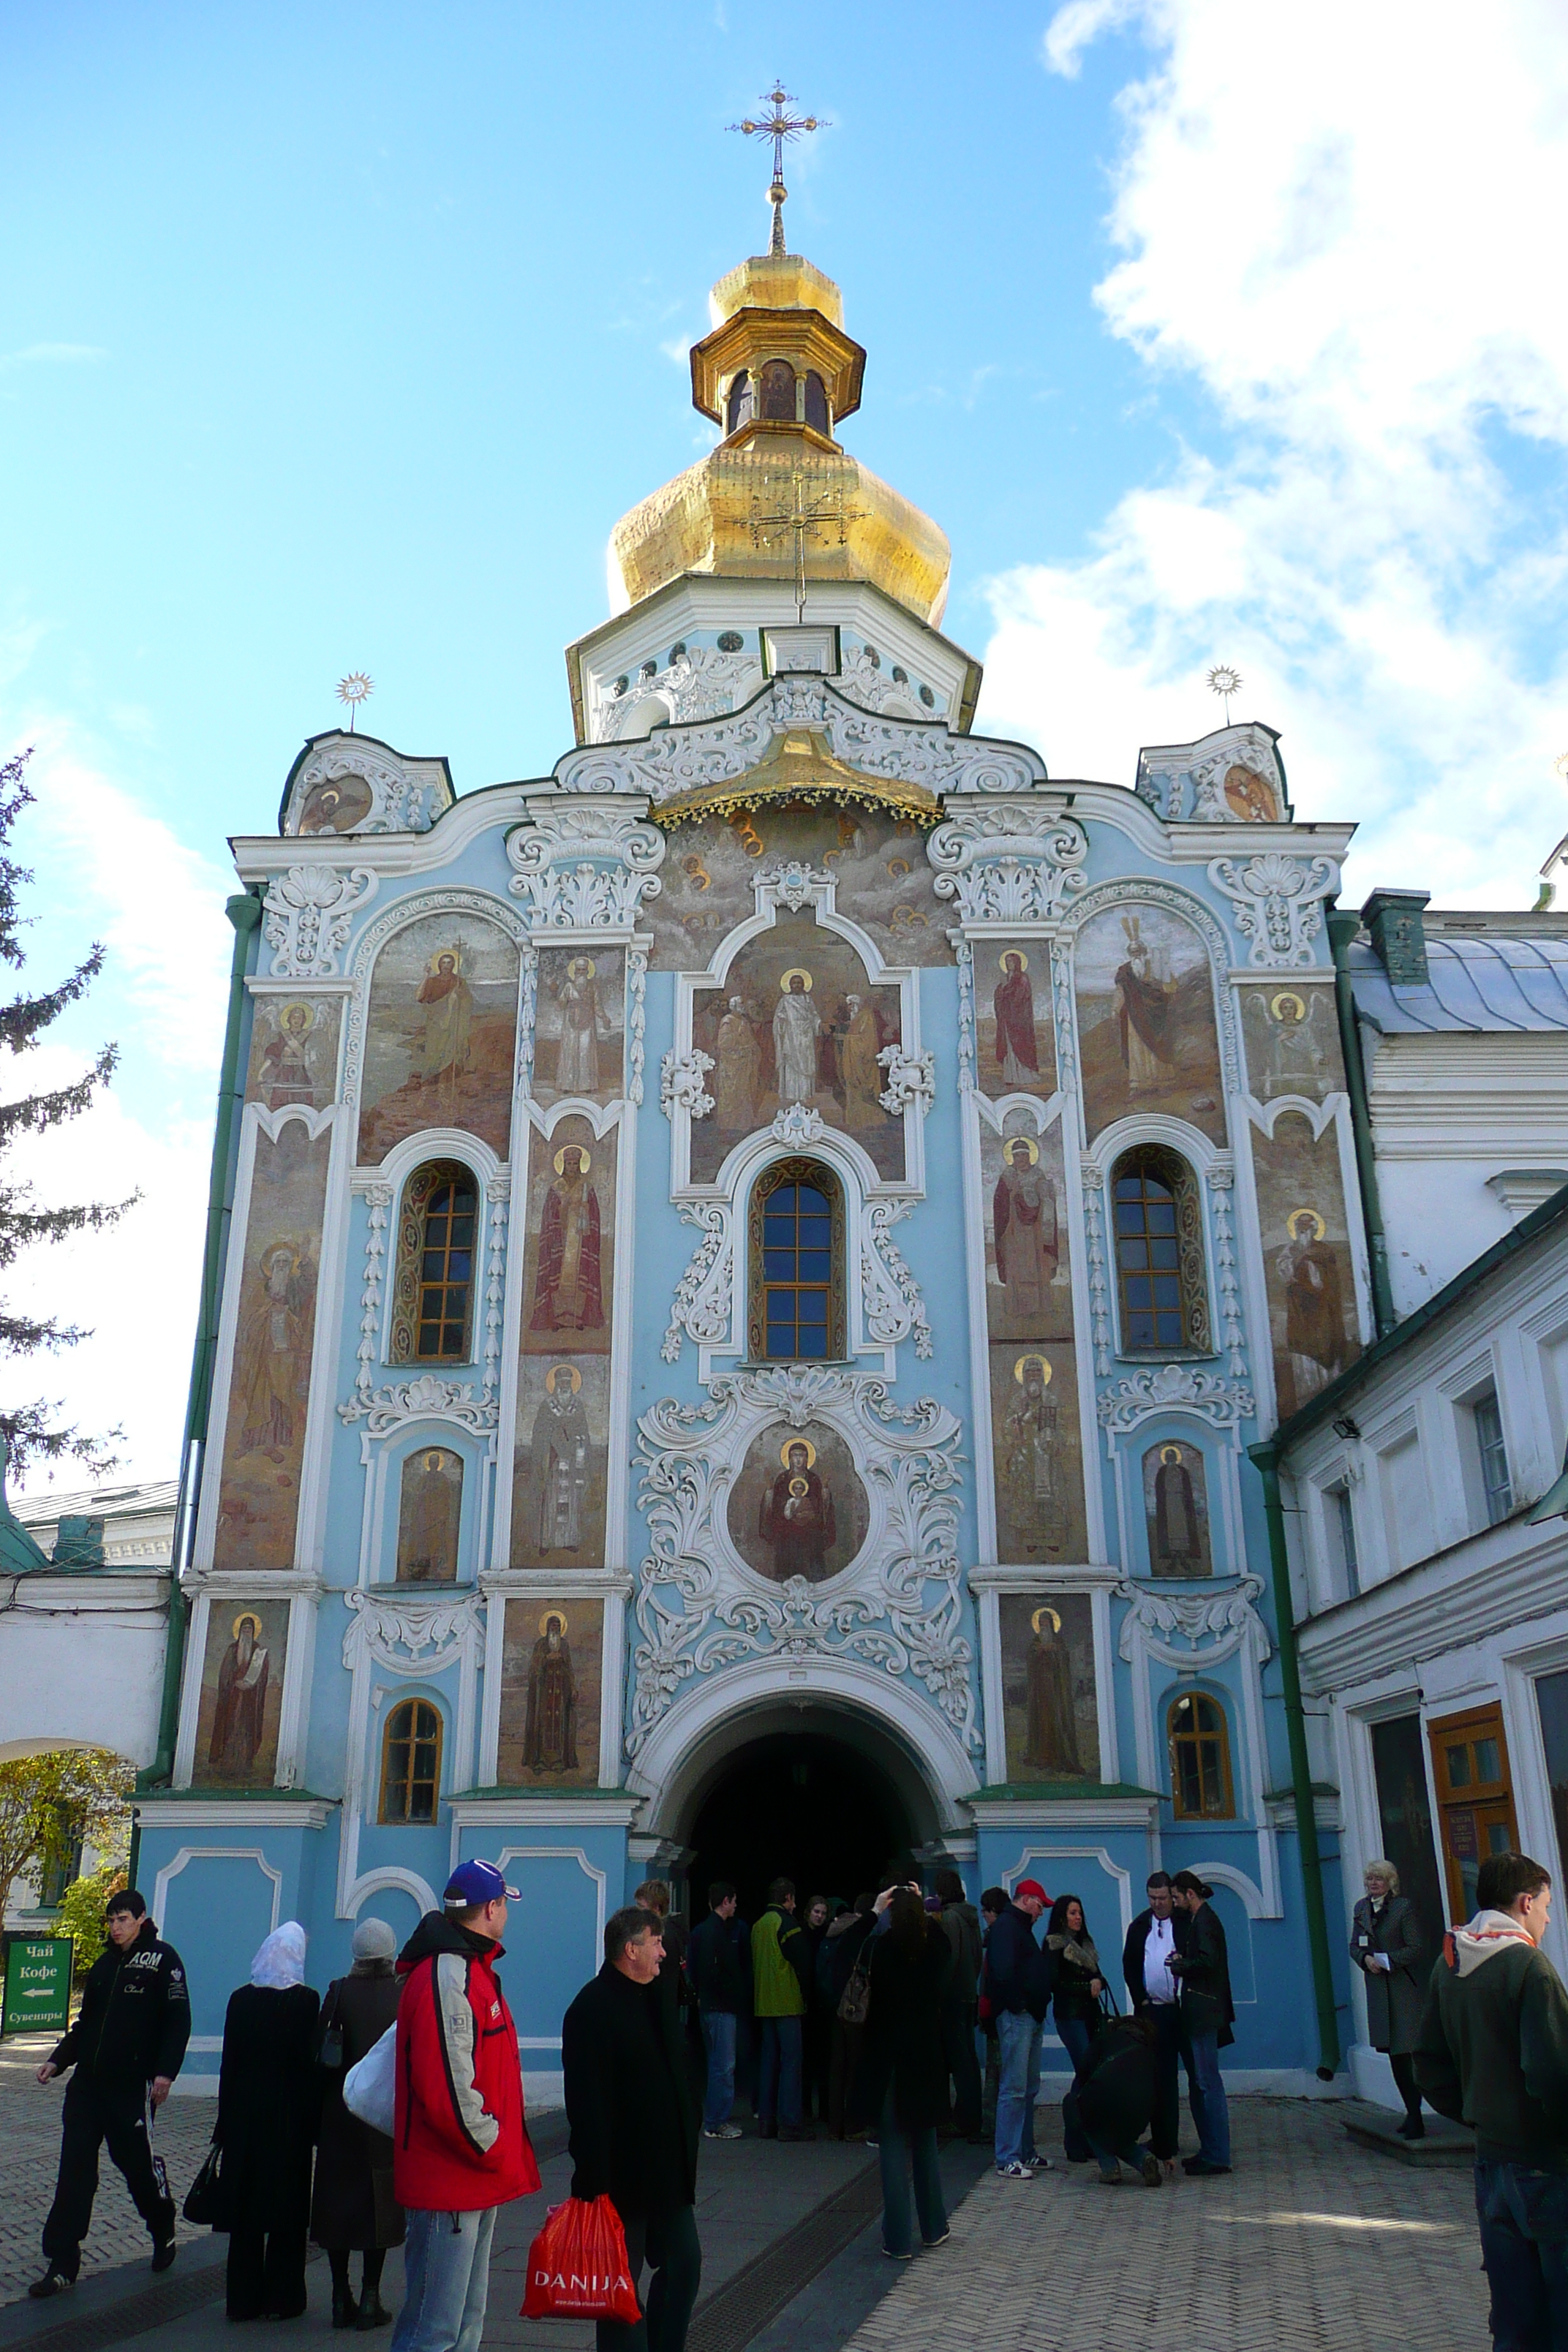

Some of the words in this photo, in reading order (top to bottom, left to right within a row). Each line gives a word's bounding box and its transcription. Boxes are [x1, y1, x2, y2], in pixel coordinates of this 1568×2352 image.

[26, 1944, 53, 1957] Чай
[129, 1951, 163, 1967] AQM
[20, 1966, 57, 1980] Кофе
[9, 2012, 63, 2024] Сувениры
[535, 2271, 628, 2291] DANIJA
